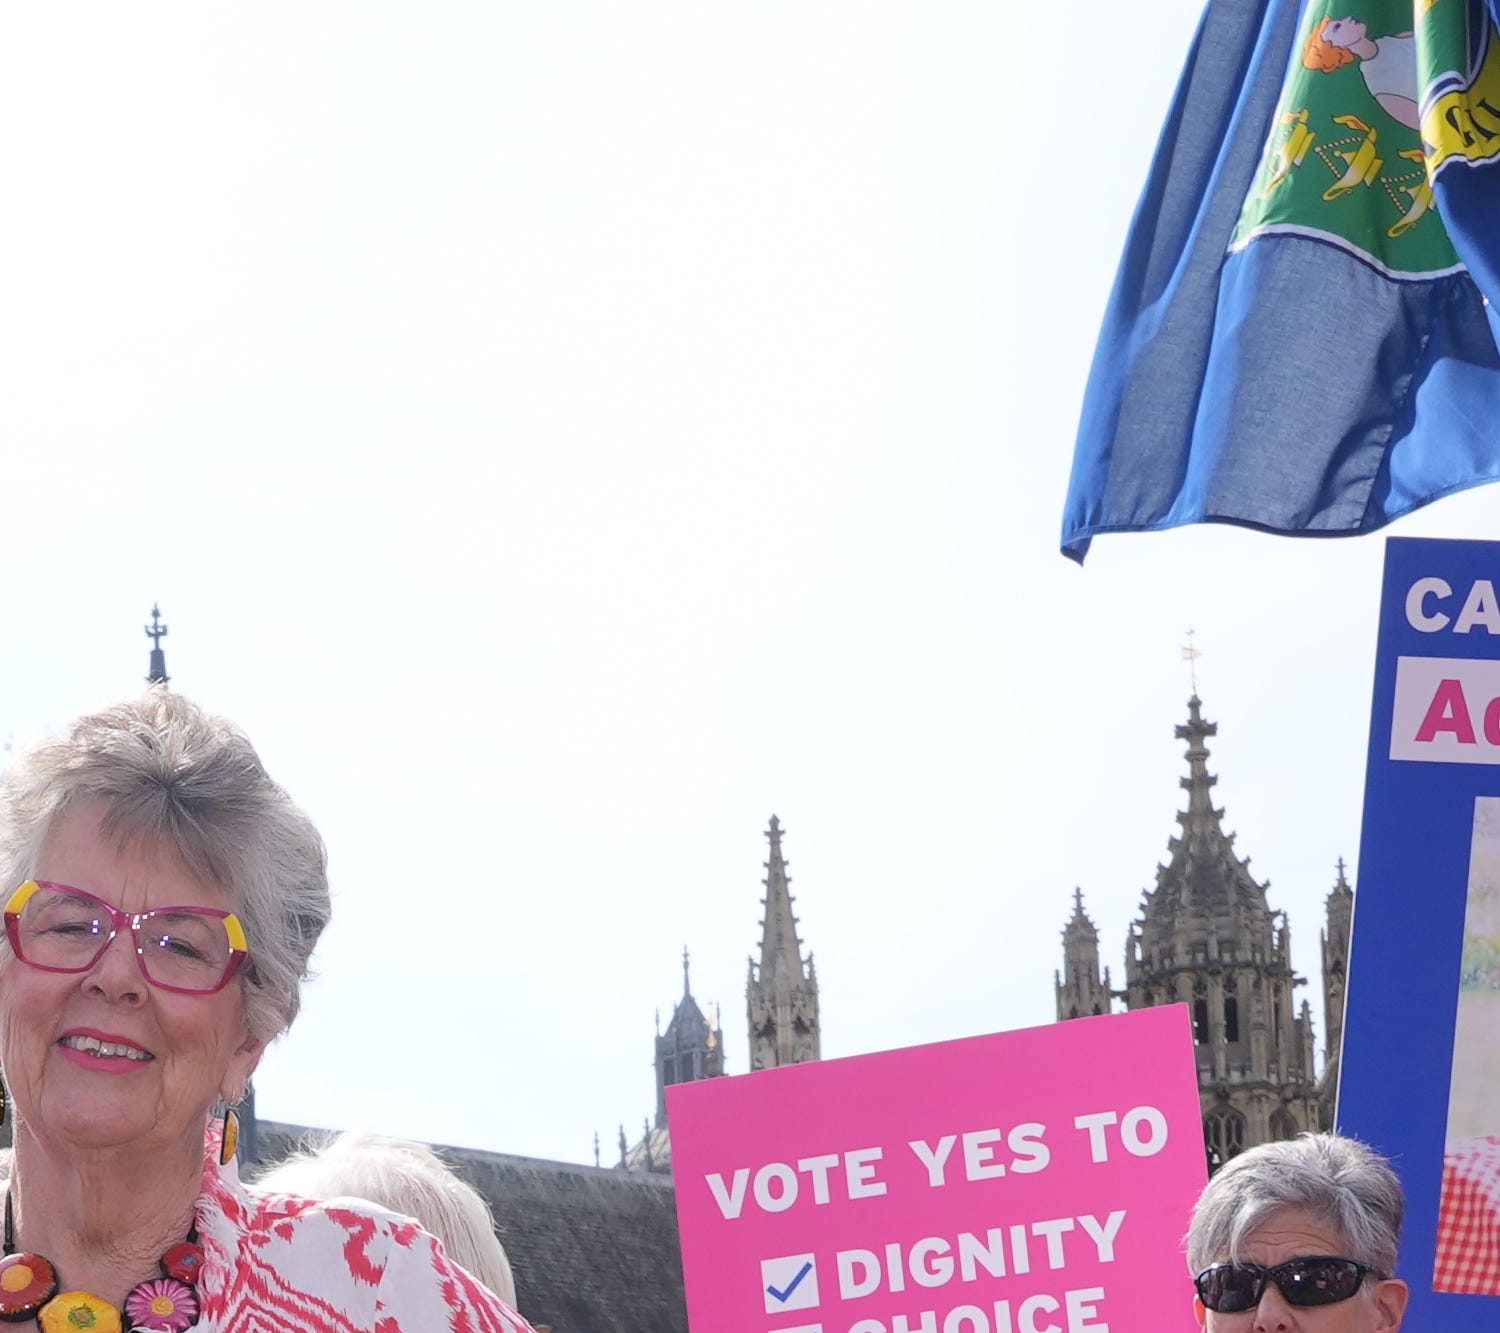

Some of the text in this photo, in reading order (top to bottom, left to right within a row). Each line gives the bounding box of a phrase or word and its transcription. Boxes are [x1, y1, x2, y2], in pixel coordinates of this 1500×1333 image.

[705, 1105, 1169, 1220] VOTE YES TO
[836, 1209, 1127, 1301] DIGNITY
